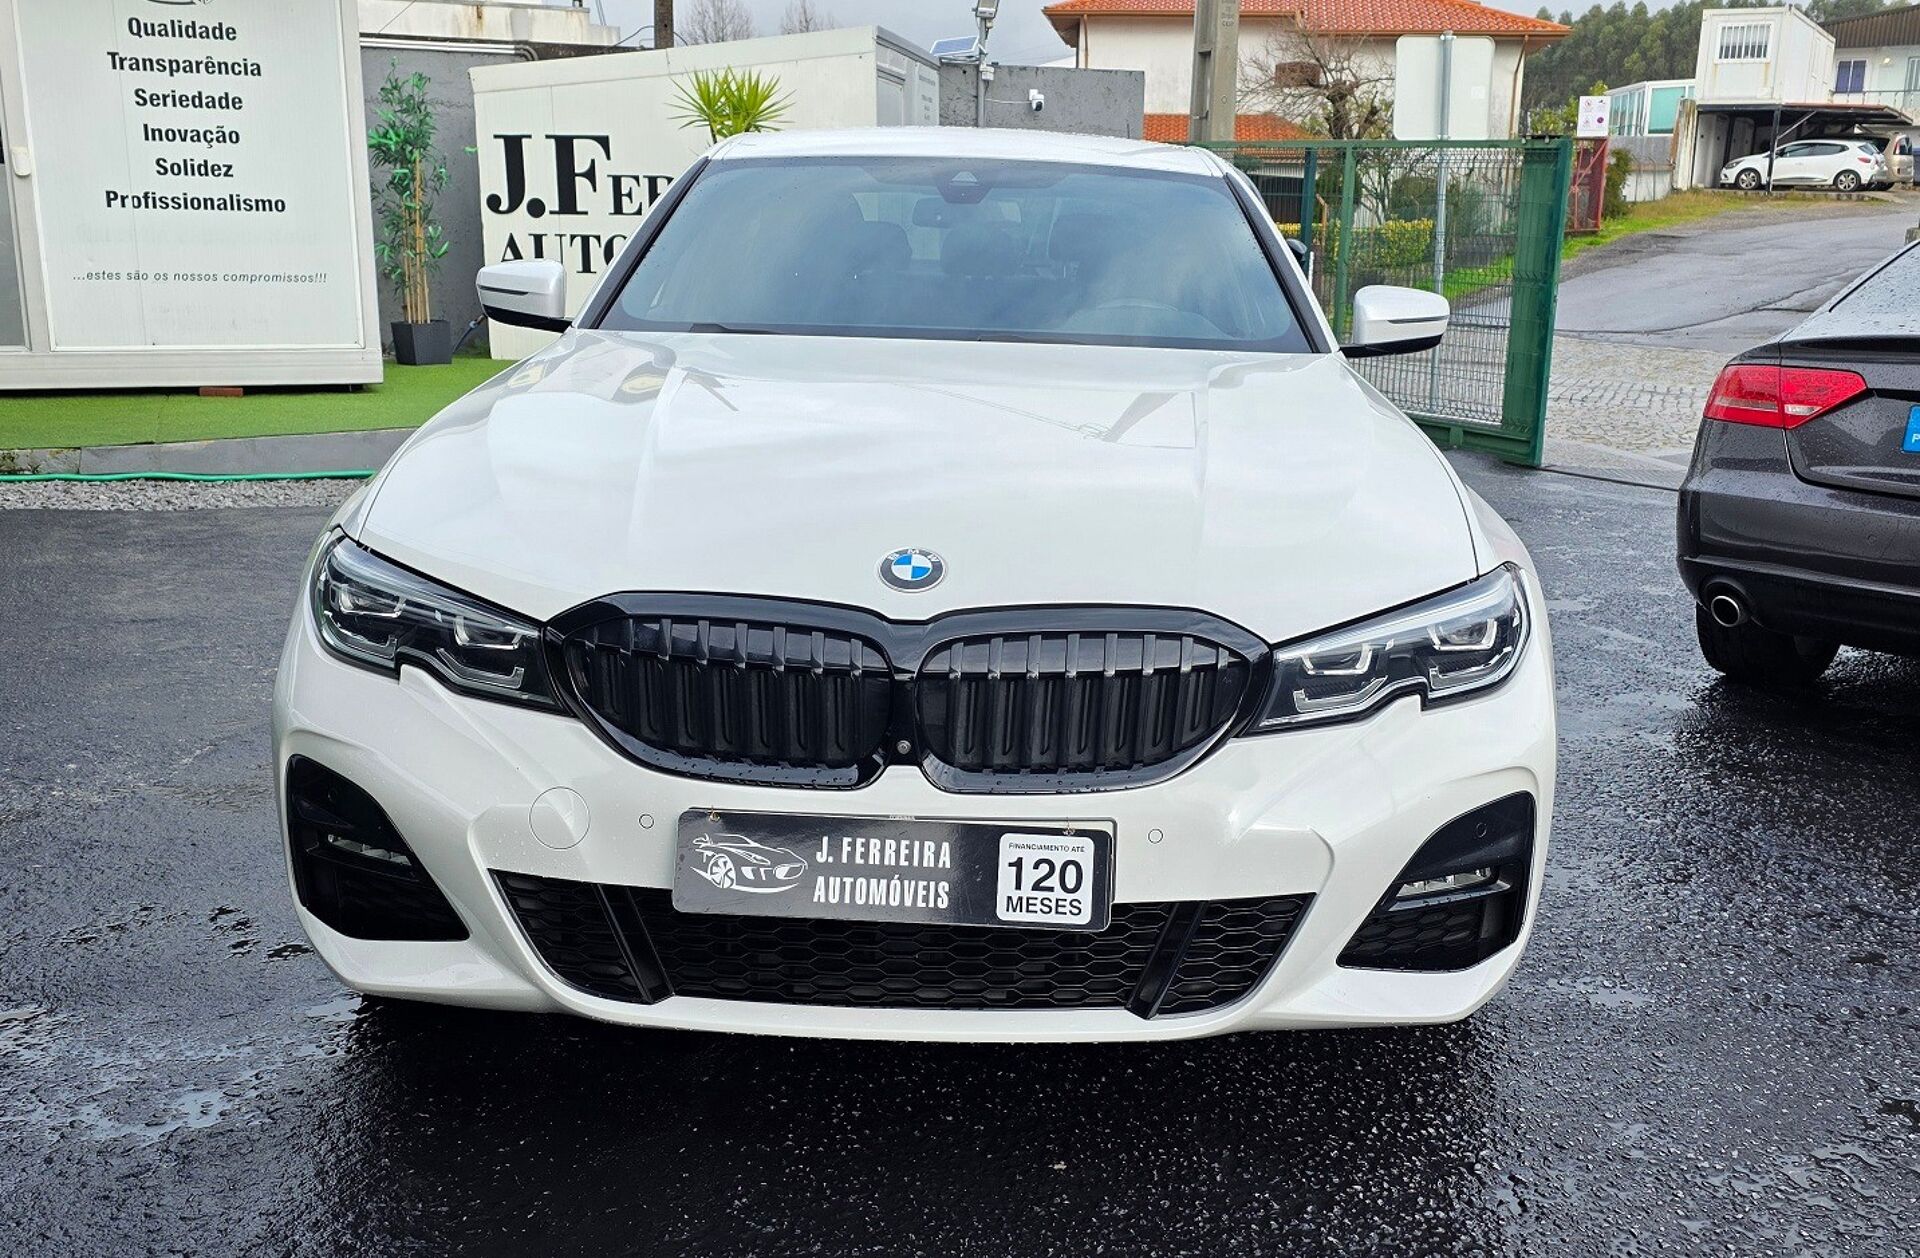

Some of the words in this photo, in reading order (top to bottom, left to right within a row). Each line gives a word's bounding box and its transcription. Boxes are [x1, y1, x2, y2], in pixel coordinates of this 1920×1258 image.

[128, 17, 237, 42] Qualidade
[106, 52, 262, 77] Transparência
[134, 88, 243, 111] Seriedade
[143, 124, 240, 149] Inovação
[155, 157, 234, 178] Solidez
[105, 190, 286, 213] Profissionalismo
[72, 270, 121, 281] ...estes
[126, 268, 149, 282] são
[153, 272, 169, 282] os
[173, 272, 218, 283] nossos
[222, 271, 327, 286] compromissos!!!
[815, 836, 834, 863] J.
[841, 837, 951, 869] FERREIRA
[1008, 842, 1070, 853] FINANCIAMENTO
[1007, 856, 1084, 894] 120
[813, 874, 949, 909] AUTOMÓVEIS
[1005, 895, 1082, 916] MESES
